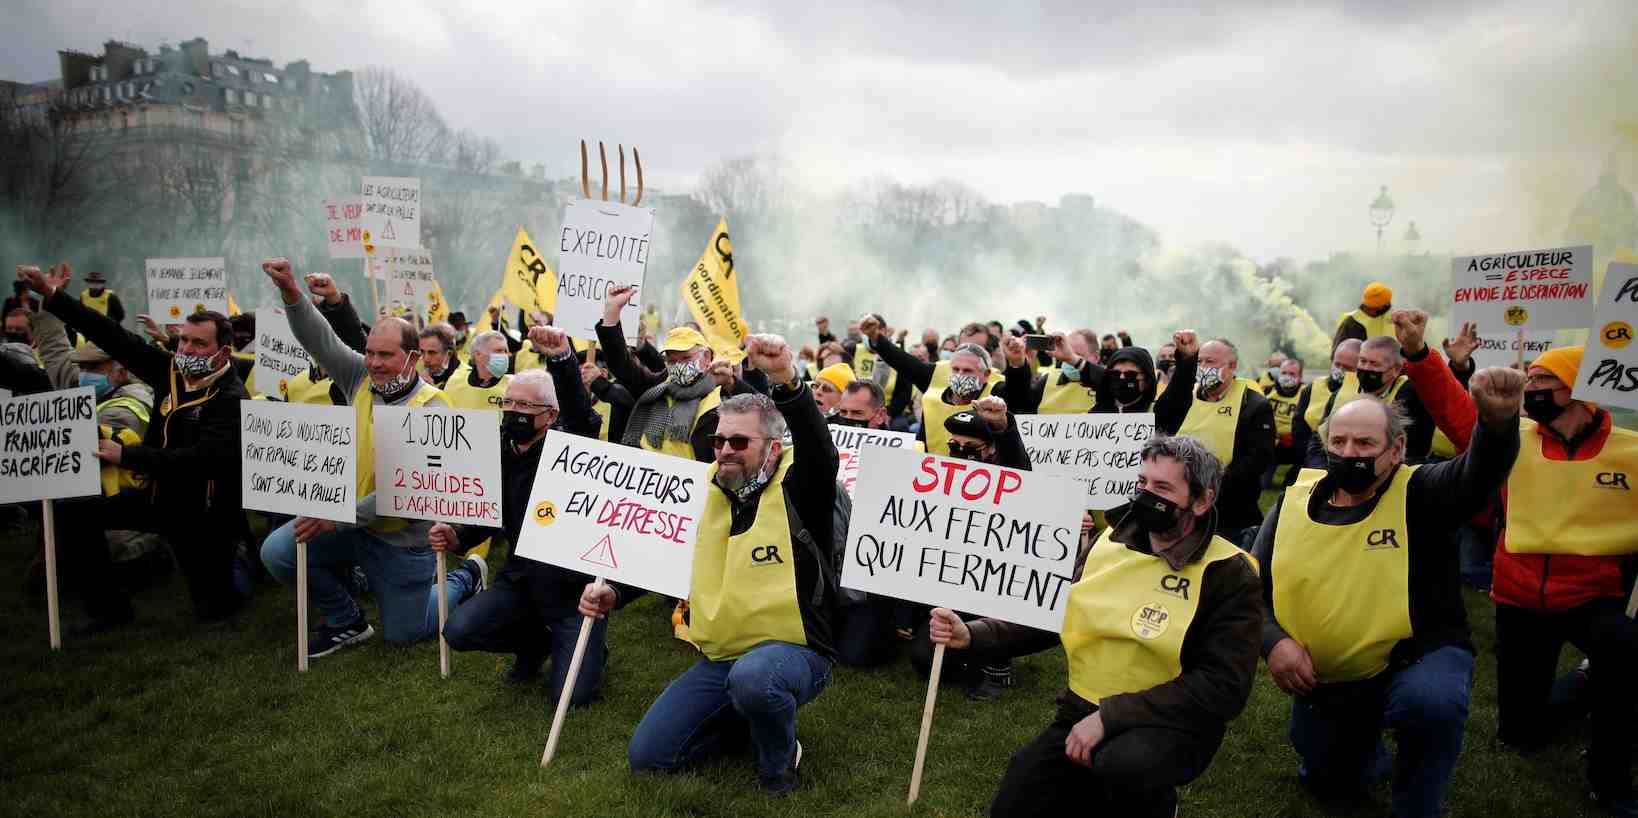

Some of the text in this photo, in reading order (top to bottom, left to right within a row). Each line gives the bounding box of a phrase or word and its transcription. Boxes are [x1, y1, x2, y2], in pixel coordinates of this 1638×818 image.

[560, 226, 649, 264] EXPLOITÉ
[1467, 251, 1574, 273] AGRICULTEUR
[557, 271, 640, 307] AGRICOE
[1455, 288, 1471, 303] EN
[1473, 286, 1500, 302] VOIE
[1502, 285, 1518, 302] DE
[689, 280, 717, 327] Rurale
[1605, 327, 1632, 341] CR
[1217, 406, 1232, 417] CR
[245, 413, 273, 438] QUAND
[276, 419, 293, 440] LES
[401, 411, 472, 452] 1 JOUR
[1020, 420, 1155, 445] SI ON L'OUVRE, C'EST
[4, 426, 72, 456] FRANÇAIS
[0, 450, 81, 478] SACRIFIÉS
[303, 451, 319, 472] LES
[320, 456, 346, 476] AGRI
[1056, 448, 1072, 466] NE
[1074, 447, 1100, 468] PAS
[1103, 449, 1143, 470] CREVE
[250, 472, 275, 493] SONT
[275, 477, 295, 496] SUR
[394, 468, 484, 497] 2 SUICIDES
[551, 444, 695, 505] AGRICULTEURS
[912, 455, 1023, 506] STOP
[1596, 472, 1631, 491] CR
[393, 494, 499, 521] D'AGRICULTEURS
[537, 506, 556, 520] CR
[564, 490, 693, 545] EN DÉTRESSE
[878, 495, 1073, 562] AUX FERMES
[1366, 528, 1401, 549] CR
[751, 545, 784, 564] CR
[855, 533, 1074, 612] QUI FERMENT
[1160, 574, 1191, 601] CR
[1140, 606, 1168, 624] STOP
